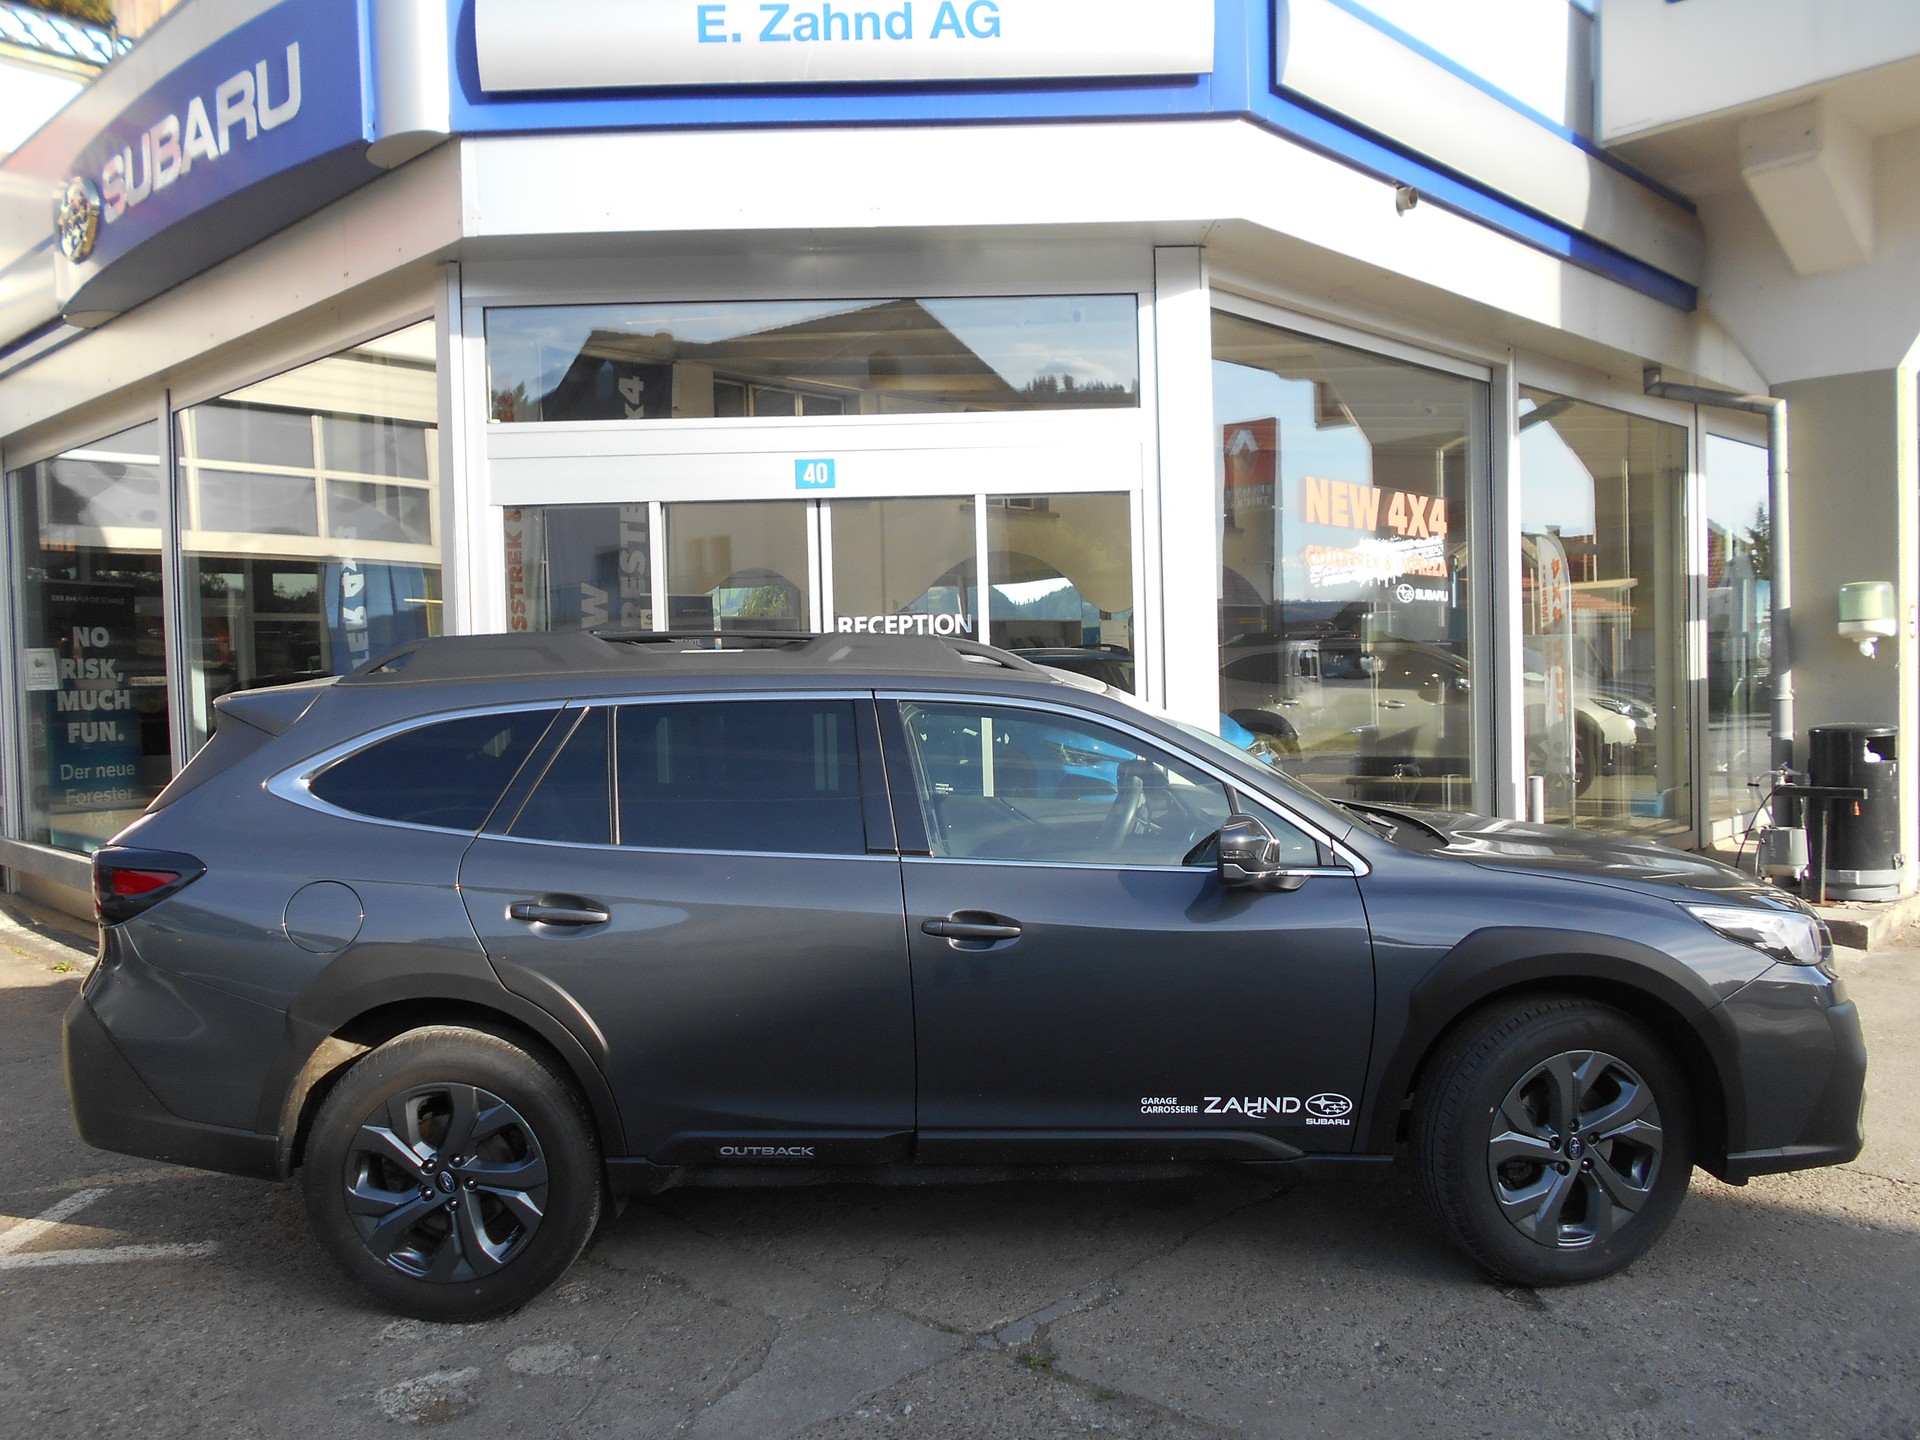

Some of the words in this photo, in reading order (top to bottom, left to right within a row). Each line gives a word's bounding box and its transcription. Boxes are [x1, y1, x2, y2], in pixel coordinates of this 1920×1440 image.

[697, 4, 741, 43] E.
[759, 1, 913, 42] Zahnd
[930, 0, 1001, 39] AG
[102, 41, 301, 224] SUBARU
[803, 462, 828, 484] 40
[1305, 475, 1382, 532] NEW
[1387, 491, 1448, 540] 4X4
[620, 506, 648, 627] RESTE
[505, 531, 528, 631] SSTREK
[838, 613, 973, 635] RECEPTION
[72, 626, 110, 648] NO
[61, 658, 124, 682] RISK,
[57, 689, 131, 711] MUCH
[67, 721, 125, 744] FUN.
[60, 764, 91, 780] Der
[96, 764, 136, 778] neue
[65, 786, 134, 806] Forester
[1141, 1097, 1178, 1105] GARAGE
[1203, 1096, 1301, 1118] ZAHND
[1141, 1105, 1199, 1114] CARROSSERIE
[1305, 1118, 1350, 1126] SUBARU
[719, 1146, 815, 1156] OUTBACK
